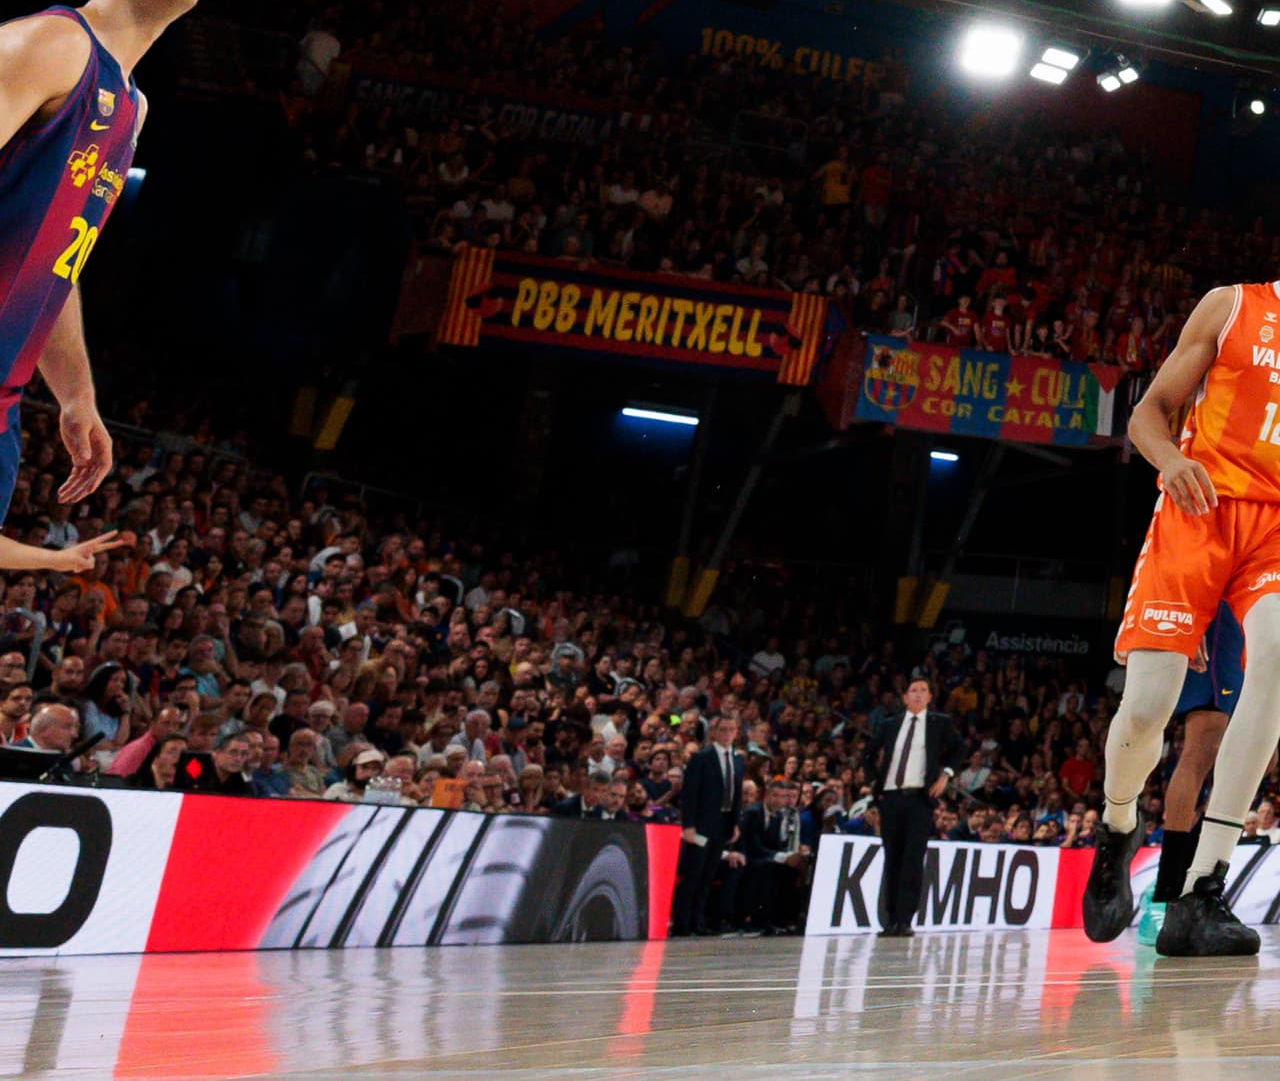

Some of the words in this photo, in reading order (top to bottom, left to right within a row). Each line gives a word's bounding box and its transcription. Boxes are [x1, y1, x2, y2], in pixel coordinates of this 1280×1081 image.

[52, 216, 98, 285] 20
[510, 277, 582, 334] PBB
[583, 287, 763, 358] MERITXELL
[924, 354, 1000, 401] SANG
[921, 396, 973, 418] COR
[1143, 607, 1194, 626] PULEVA
[830, 840, 1041, 929] KMHO
